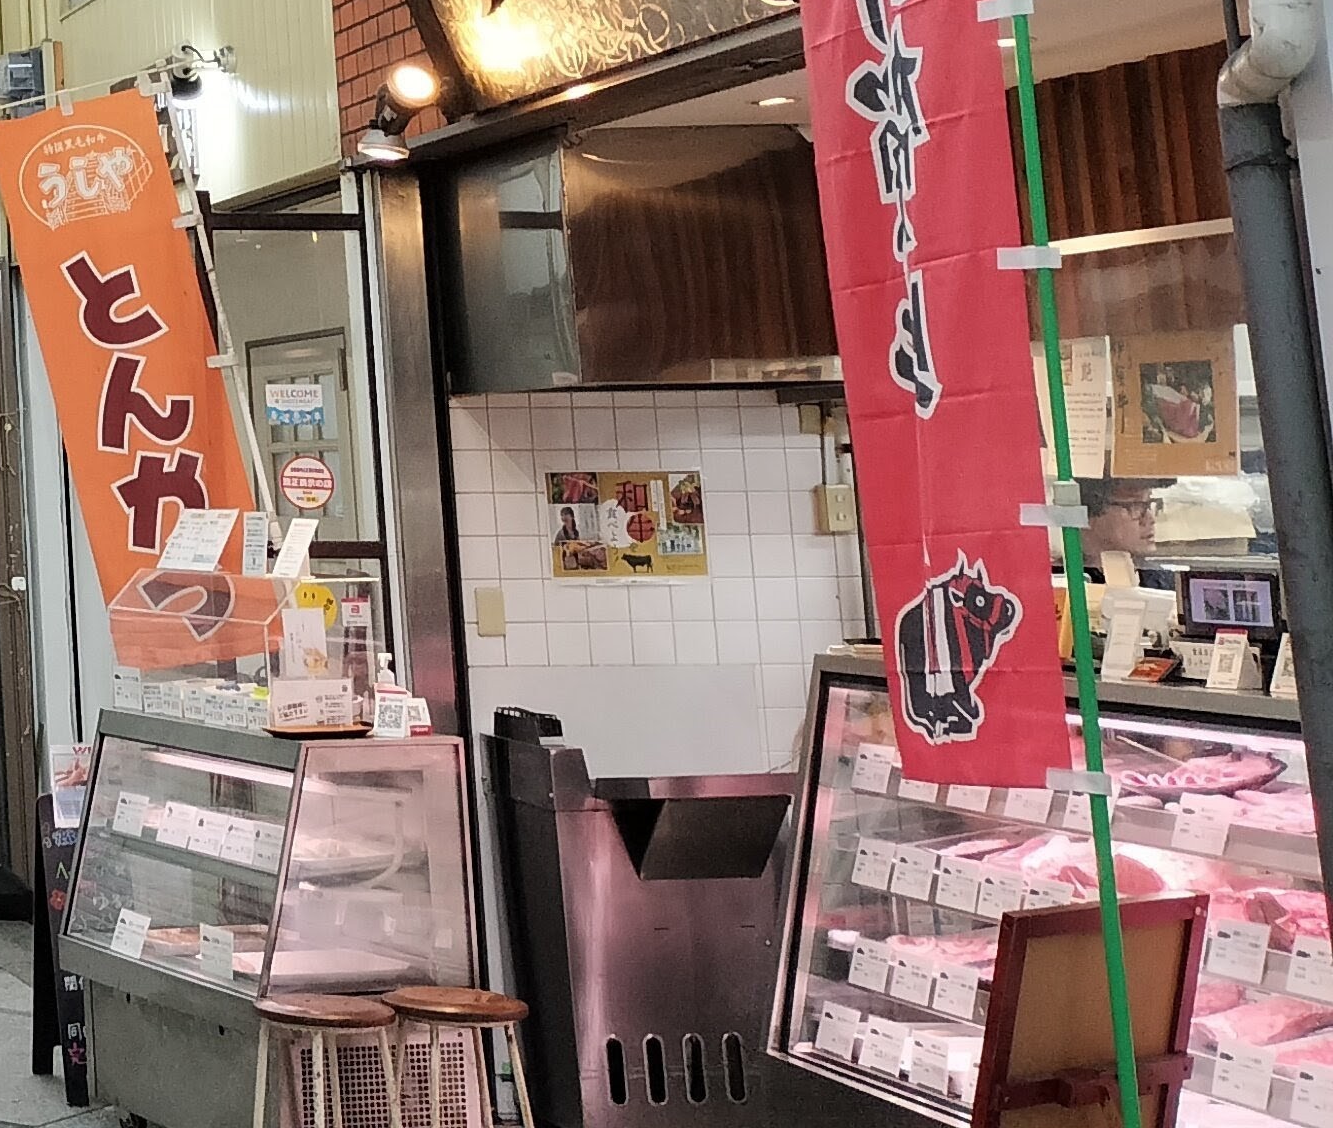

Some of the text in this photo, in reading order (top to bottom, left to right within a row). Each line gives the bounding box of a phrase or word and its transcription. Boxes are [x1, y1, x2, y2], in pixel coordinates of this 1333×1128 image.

[37, 146, 133, 209] うしや
[270, 389, 319, 398] WELCOME
